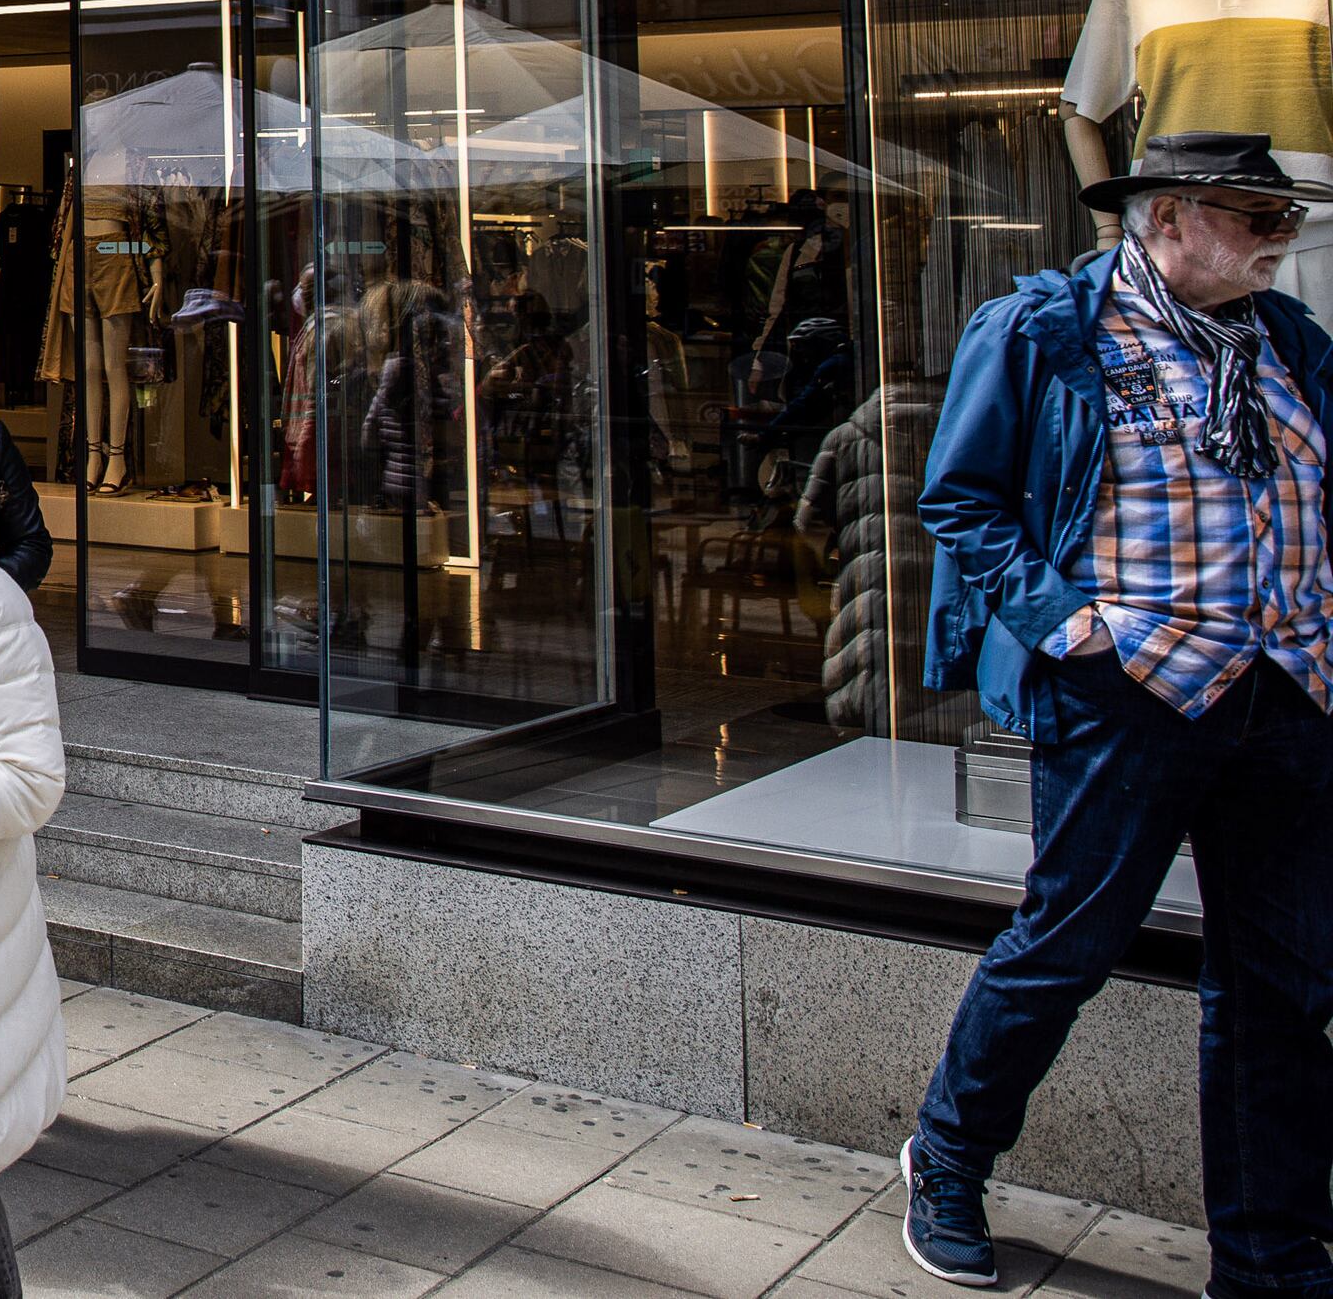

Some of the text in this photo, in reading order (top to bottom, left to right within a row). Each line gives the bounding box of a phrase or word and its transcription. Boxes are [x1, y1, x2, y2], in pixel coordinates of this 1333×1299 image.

[1105, 362, 1151, 377] CAMP DAVID
[1107, 402, 1201, 427] MALTA
